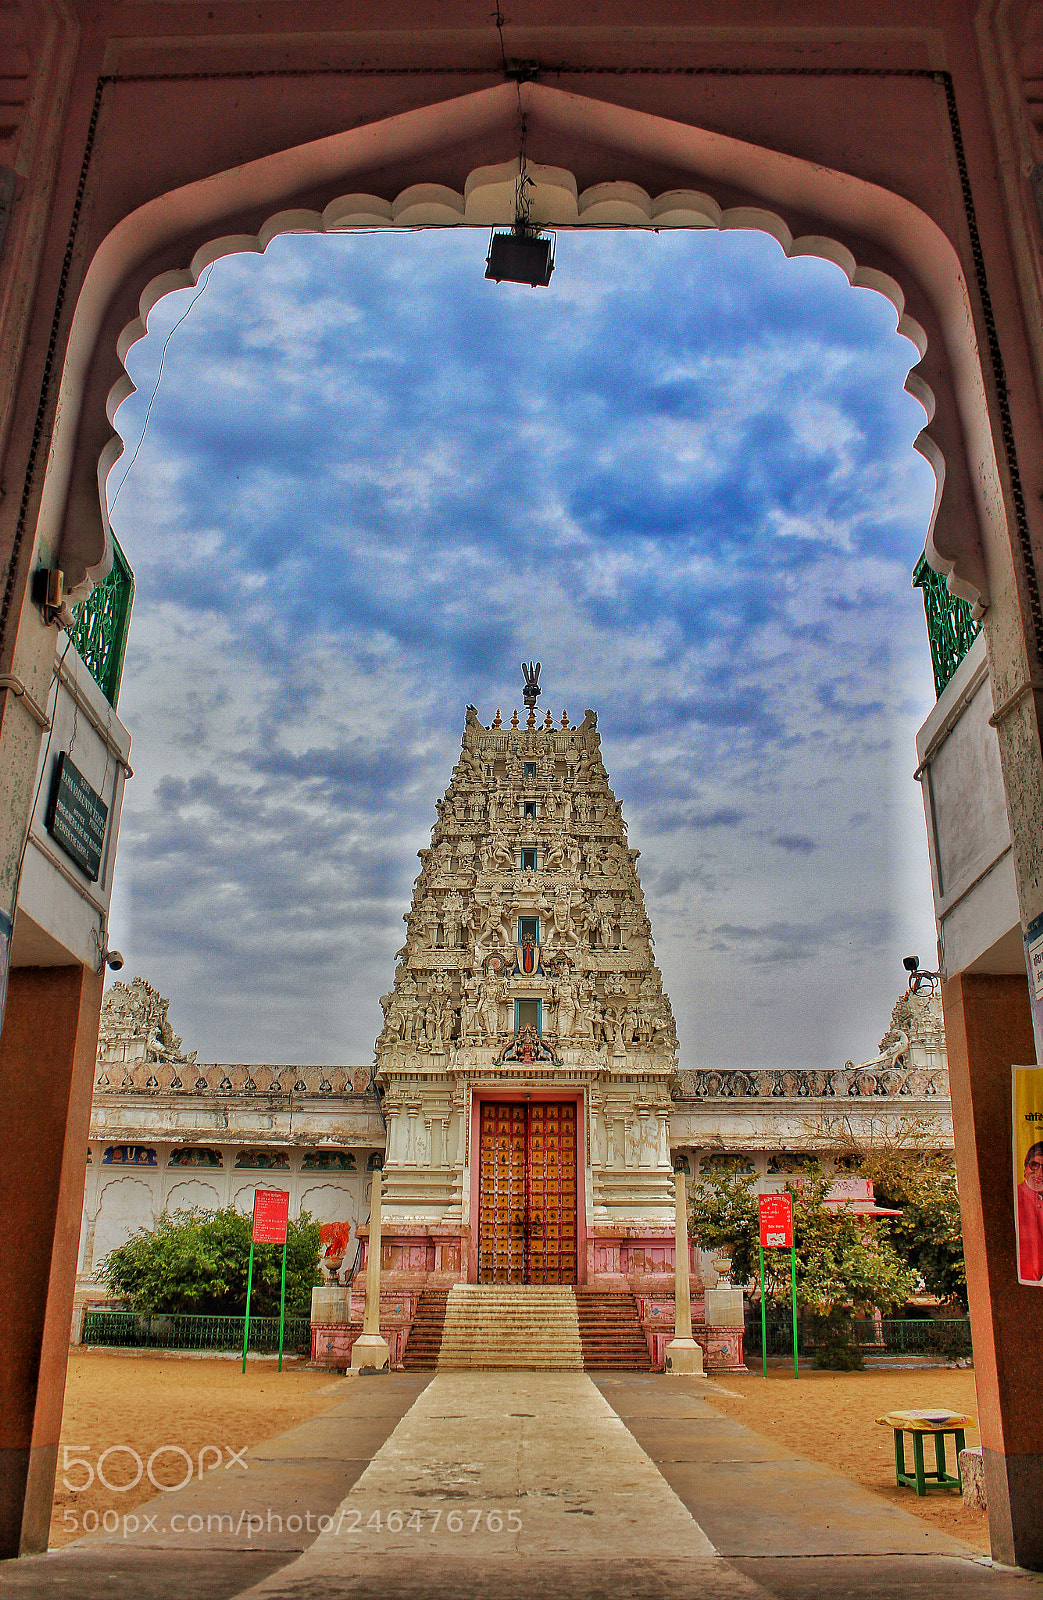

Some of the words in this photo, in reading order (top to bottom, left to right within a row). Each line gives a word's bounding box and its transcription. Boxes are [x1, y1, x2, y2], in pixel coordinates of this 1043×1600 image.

[54, 815, 60, 828] TO
[59, 819, 71, 840] ENTER
[69, 832, 77, 848] THE
[75, 839, 88, 860] TEMPLE
[57, 799, 77, 829] FOREIGNERS
[76, 822, 84, 838] ARE
[88, 835, 101, 858] ALLOWED
[72, 806, 85, 825] NOTICE
